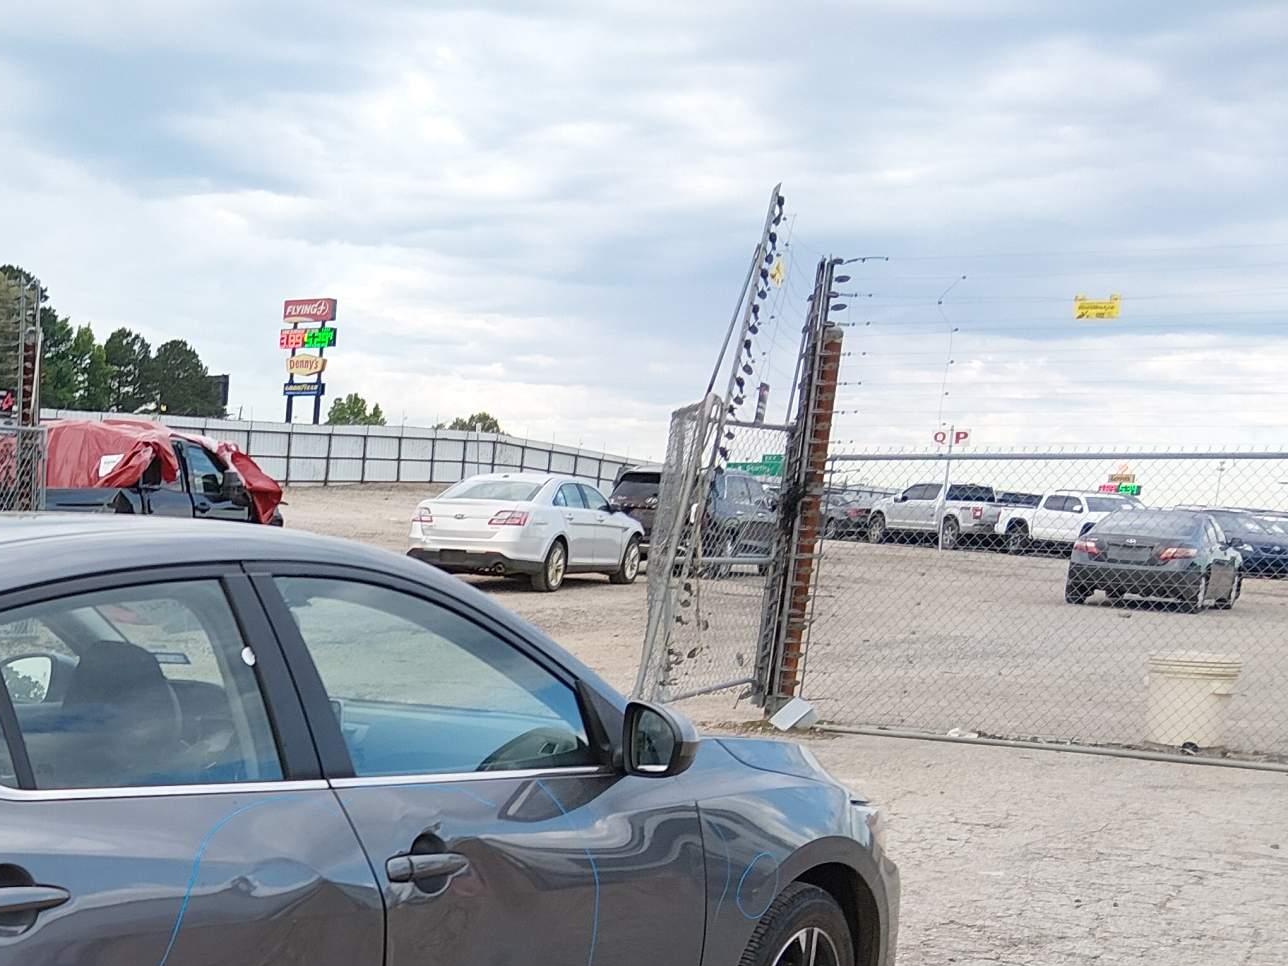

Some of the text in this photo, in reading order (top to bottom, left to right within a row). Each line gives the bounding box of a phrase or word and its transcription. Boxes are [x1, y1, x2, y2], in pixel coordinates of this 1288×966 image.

[289, 359, 319, 370] Denny's
[933, 431, 969, 445] Q P
